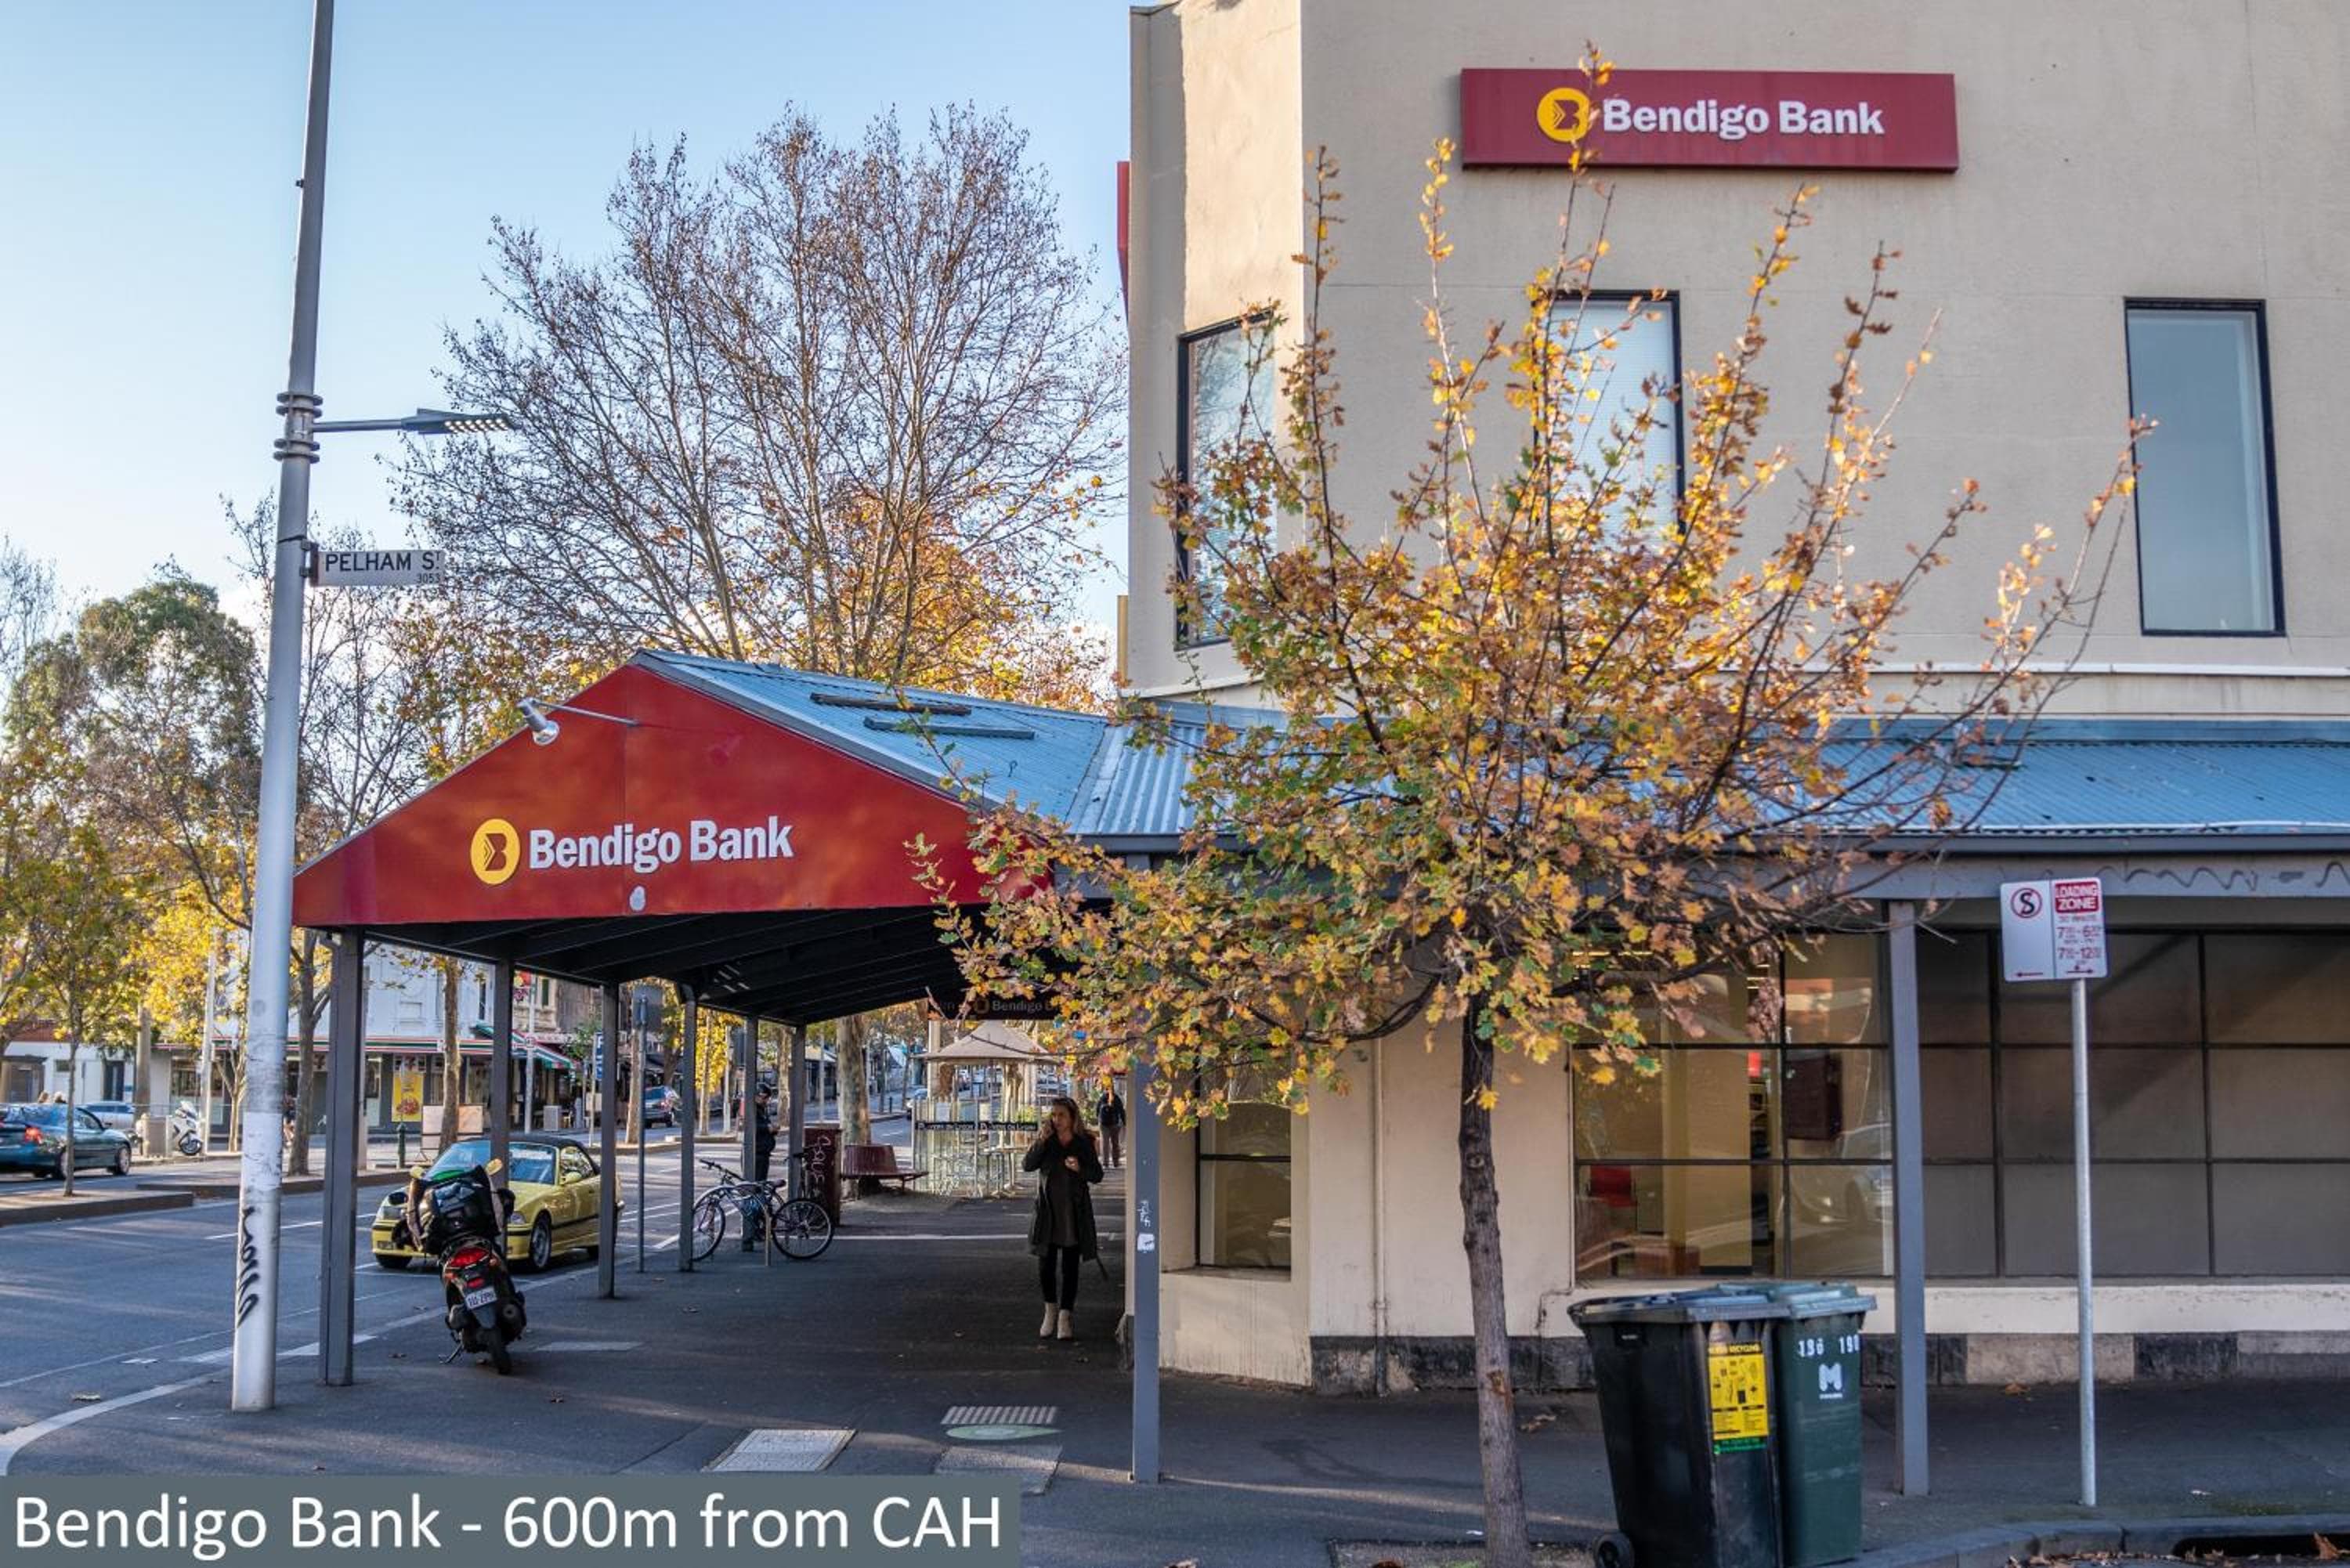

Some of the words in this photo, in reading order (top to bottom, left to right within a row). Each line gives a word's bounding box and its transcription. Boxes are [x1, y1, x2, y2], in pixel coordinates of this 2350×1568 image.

[1602, 98, 1769, 140] Bendigo
[1778, 100, 1885, 135] Bank
[325, 552, 411, 572] PELHAM
[417, 573, 441, 583] 3053
[529, 823, 682, 874] Bendigo
[689, 815, 794, 862] Bank
[2056, 898, 2097, 911] ZONE
[992, 999, 1043, 1014] Bendigo
